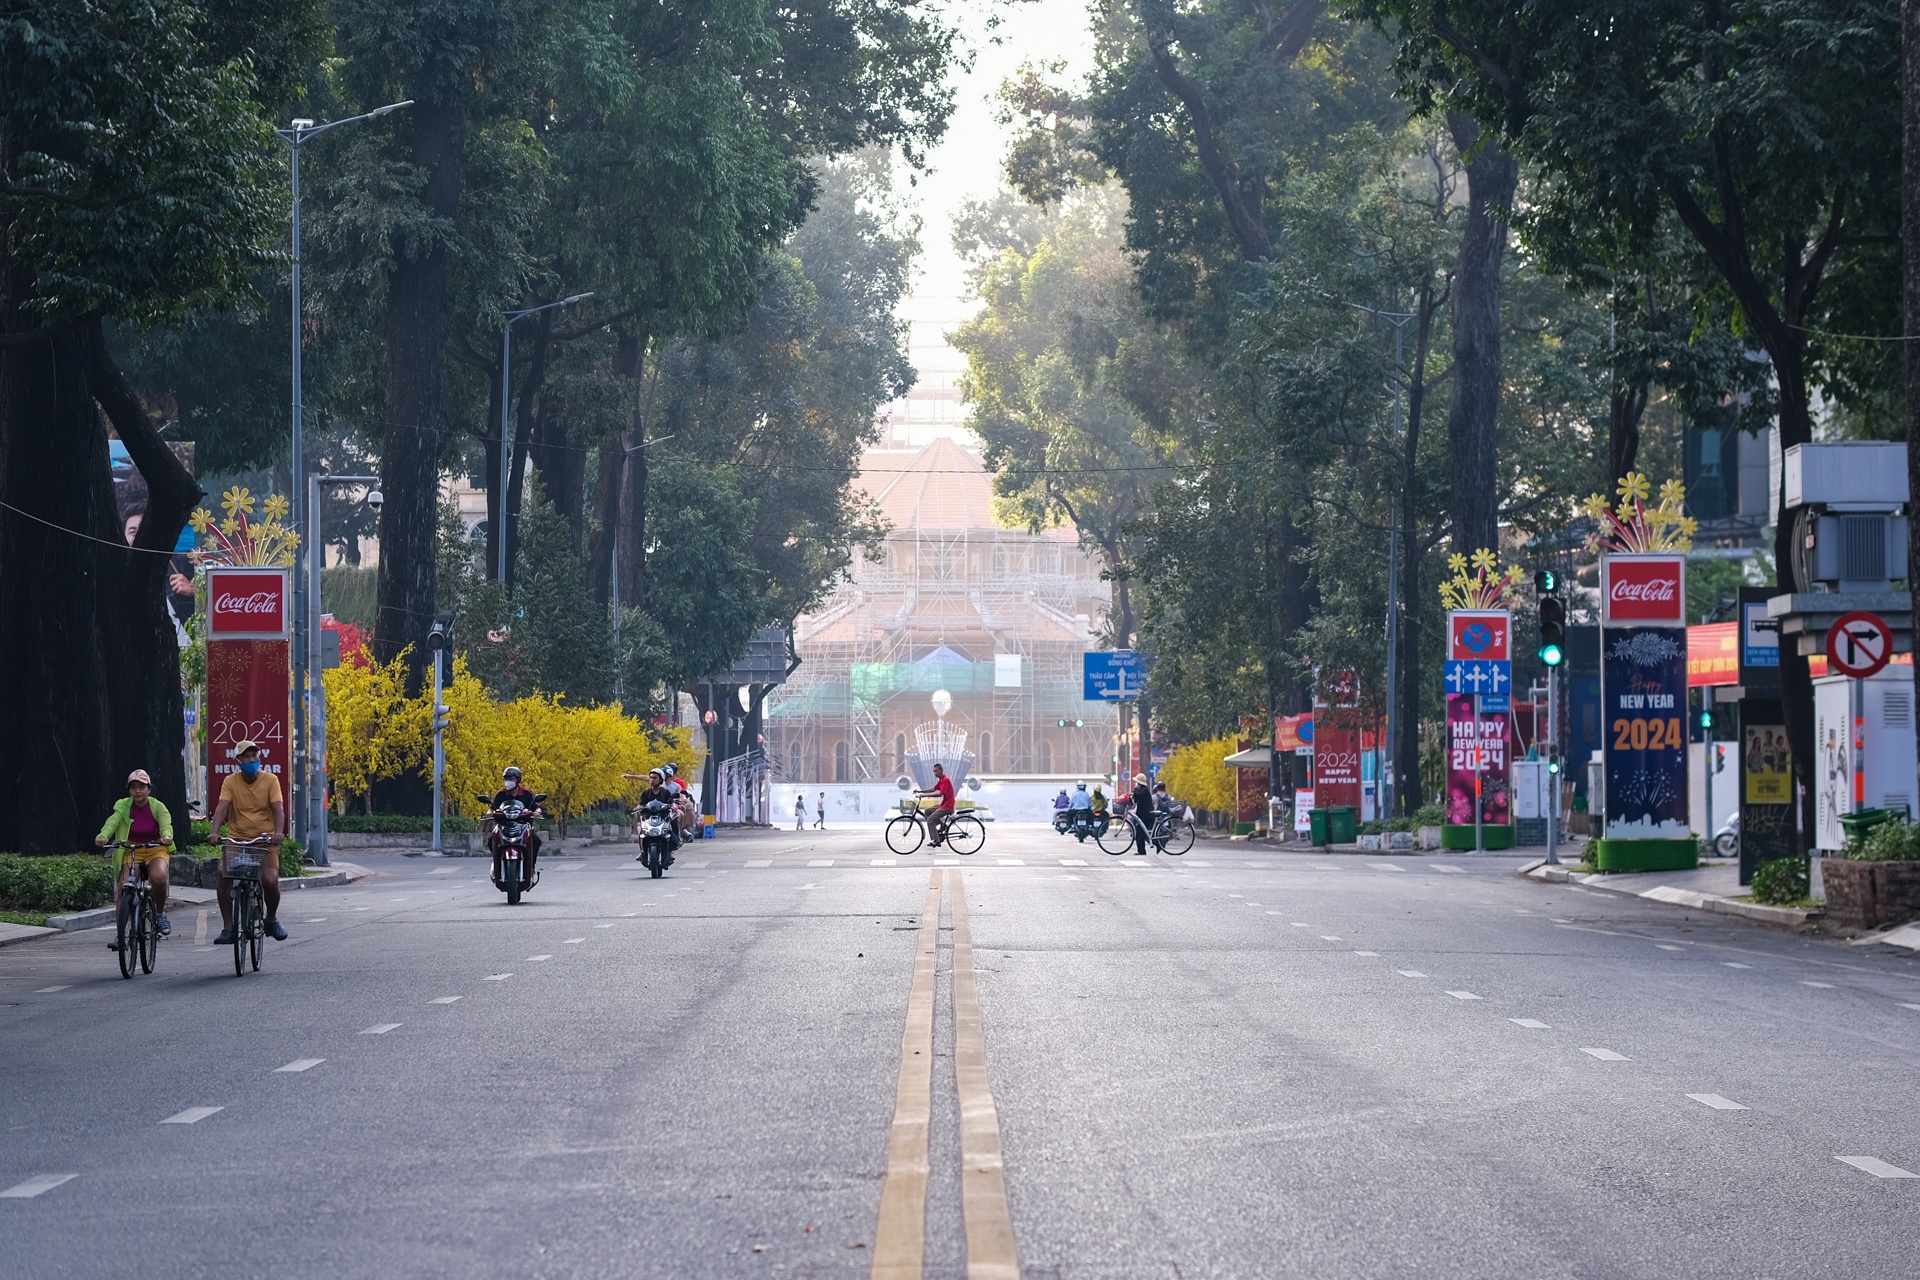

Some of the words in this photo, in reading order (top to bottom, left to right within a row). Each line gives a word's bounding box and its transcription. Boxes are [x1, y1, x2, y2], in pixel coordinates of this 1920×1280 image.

[1545, 573, 1554, 590] 3
[1611, 579, 1677, 601] Coca-Cola
[215, 592, 279, 613] Coca-Cola
[1626, 674, 1663, 695] Happy
[1620, 695, 1644, 709] NEW
[1648, 694, 1675, 709] YEAR
[212, 720, 284, 744] 2024
[1613, 718, 1682, 751] 2024
[1453, 739, 1476, 750] NEW
[1317, 752, 1358, 767] 2024
[1453, 750, 1504, 770] 2024
[1242, 767, 1268, 780] 2024
